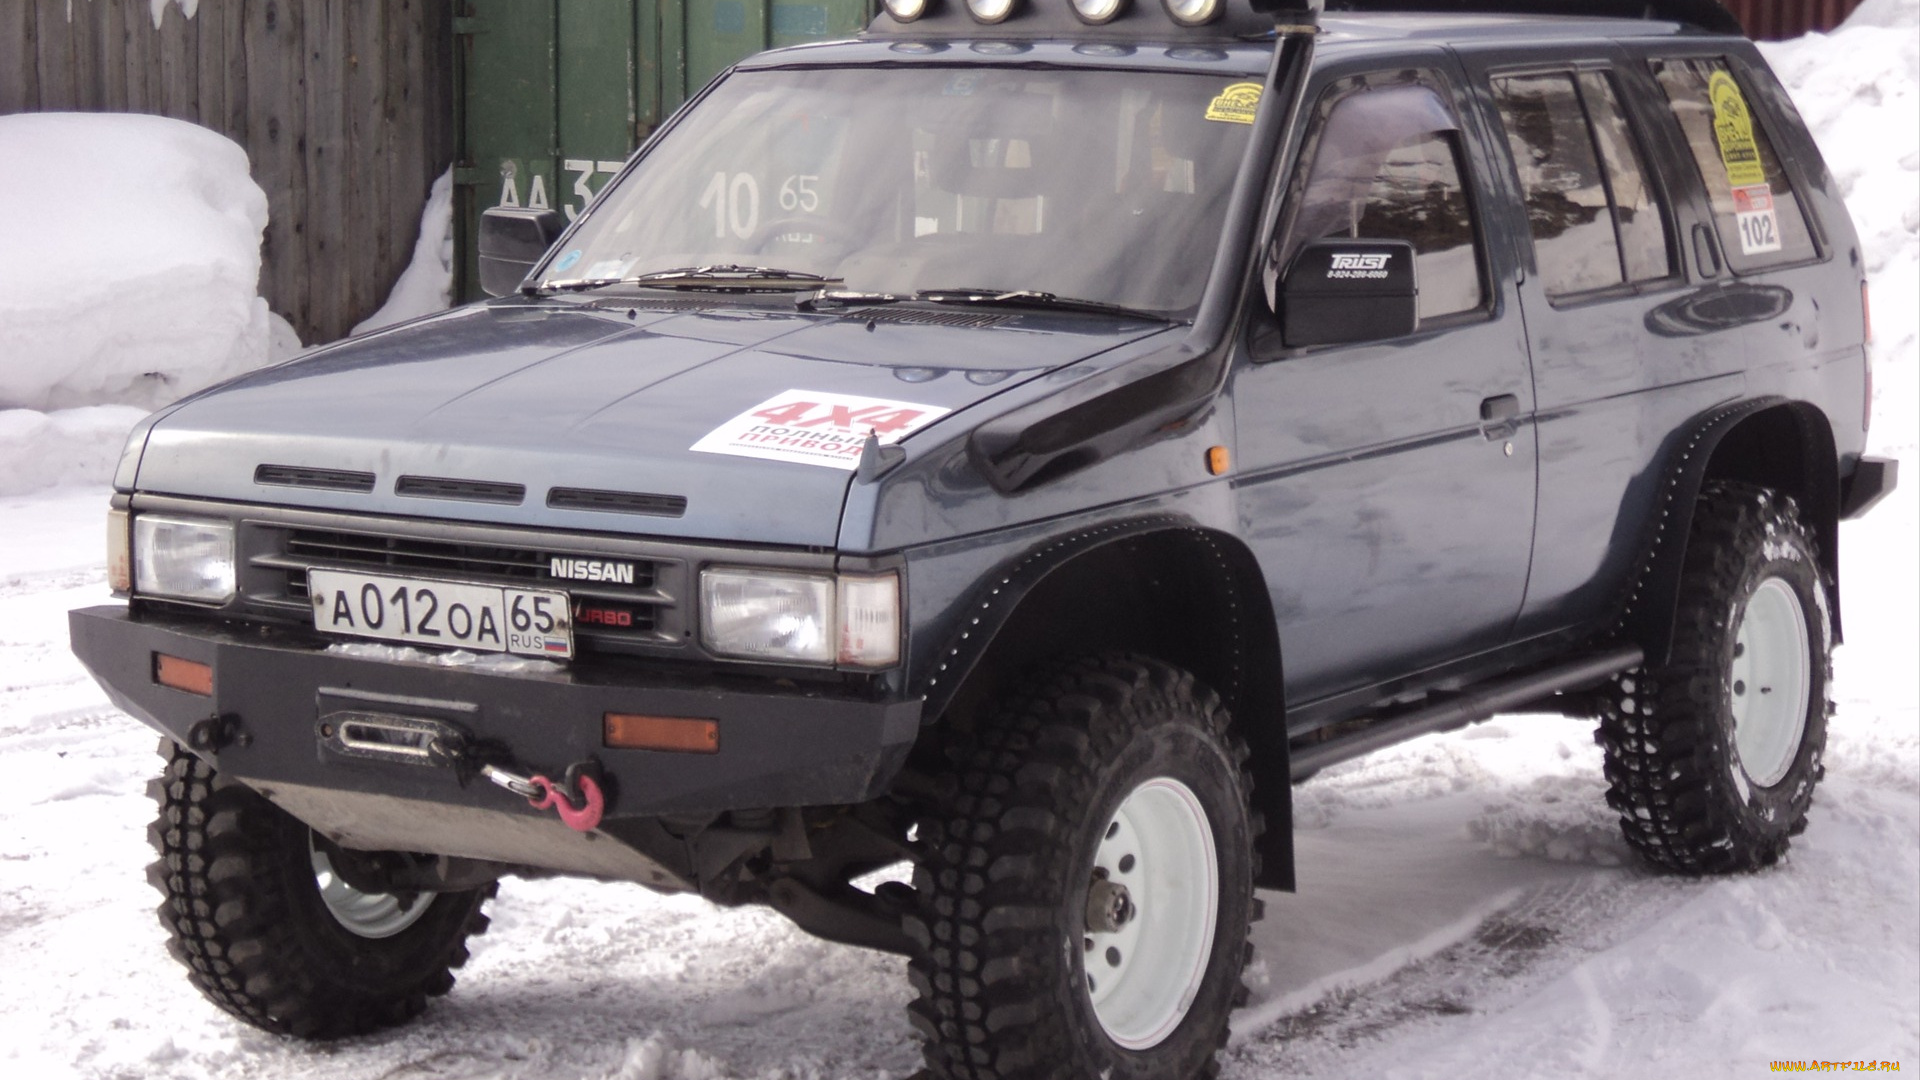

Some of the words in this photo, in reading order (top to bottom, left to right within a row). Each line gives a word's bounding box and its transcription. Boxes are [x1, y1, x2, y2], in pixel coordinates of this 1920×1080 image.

[699, 171, 760, 240] 10
[779, 174, 819, 213] 65
[1741, 214, 1775, 248] 102
[1331, 254, 1392, 269] TRUST
[738, 432, 863, 457] ПРИВОД
[550, 558, 634, 584] NISSAN
[510, 595, 555, 634] 65
[511, 633, 543, 650] RUS
